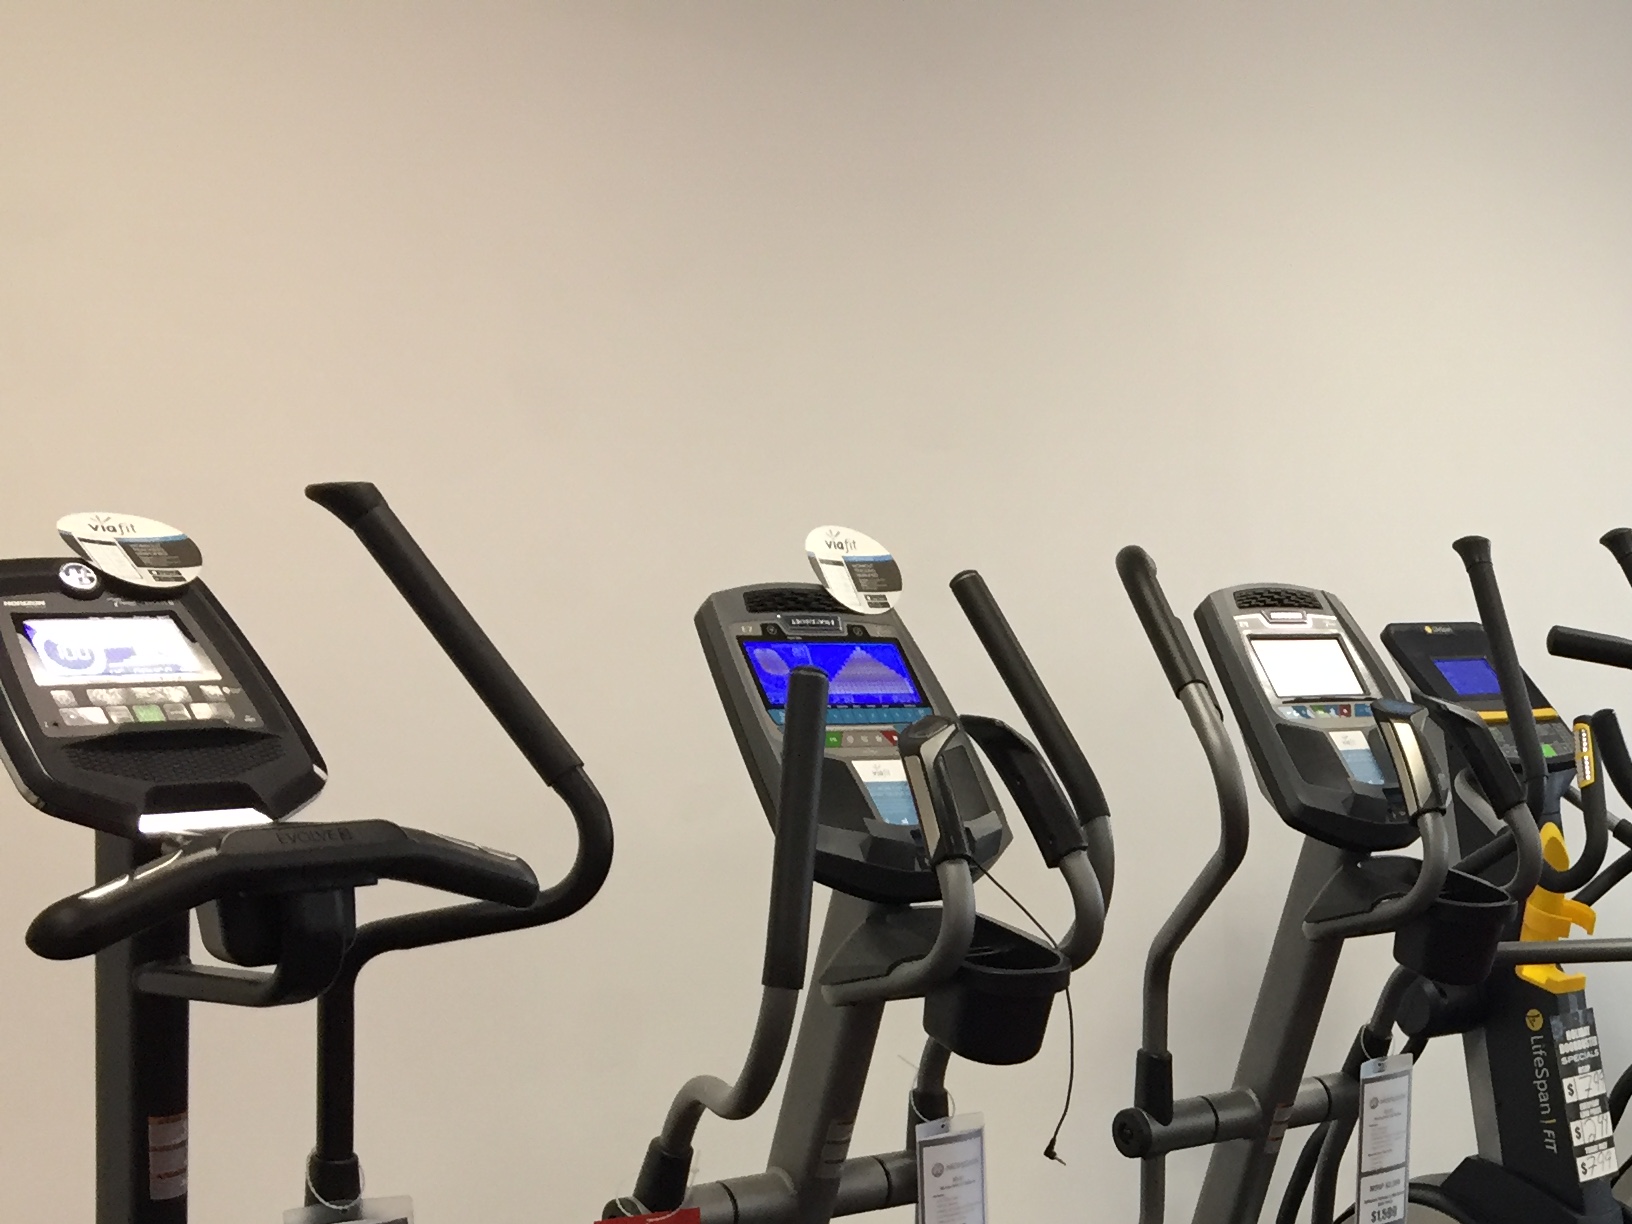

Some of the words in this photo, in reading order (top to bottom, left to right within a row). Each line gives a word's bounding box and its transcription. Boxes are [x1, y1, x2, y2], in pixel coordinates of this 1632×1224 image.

[87, 523, 136, 535] viafit
[825, 539, 857, 553] viafit
[1561, 1048, 1600, 1066] SPECIALS
[1530, 1035, 1552, 1120] LifeSpan
[1543, 1129, 1557, 1154] FIT
